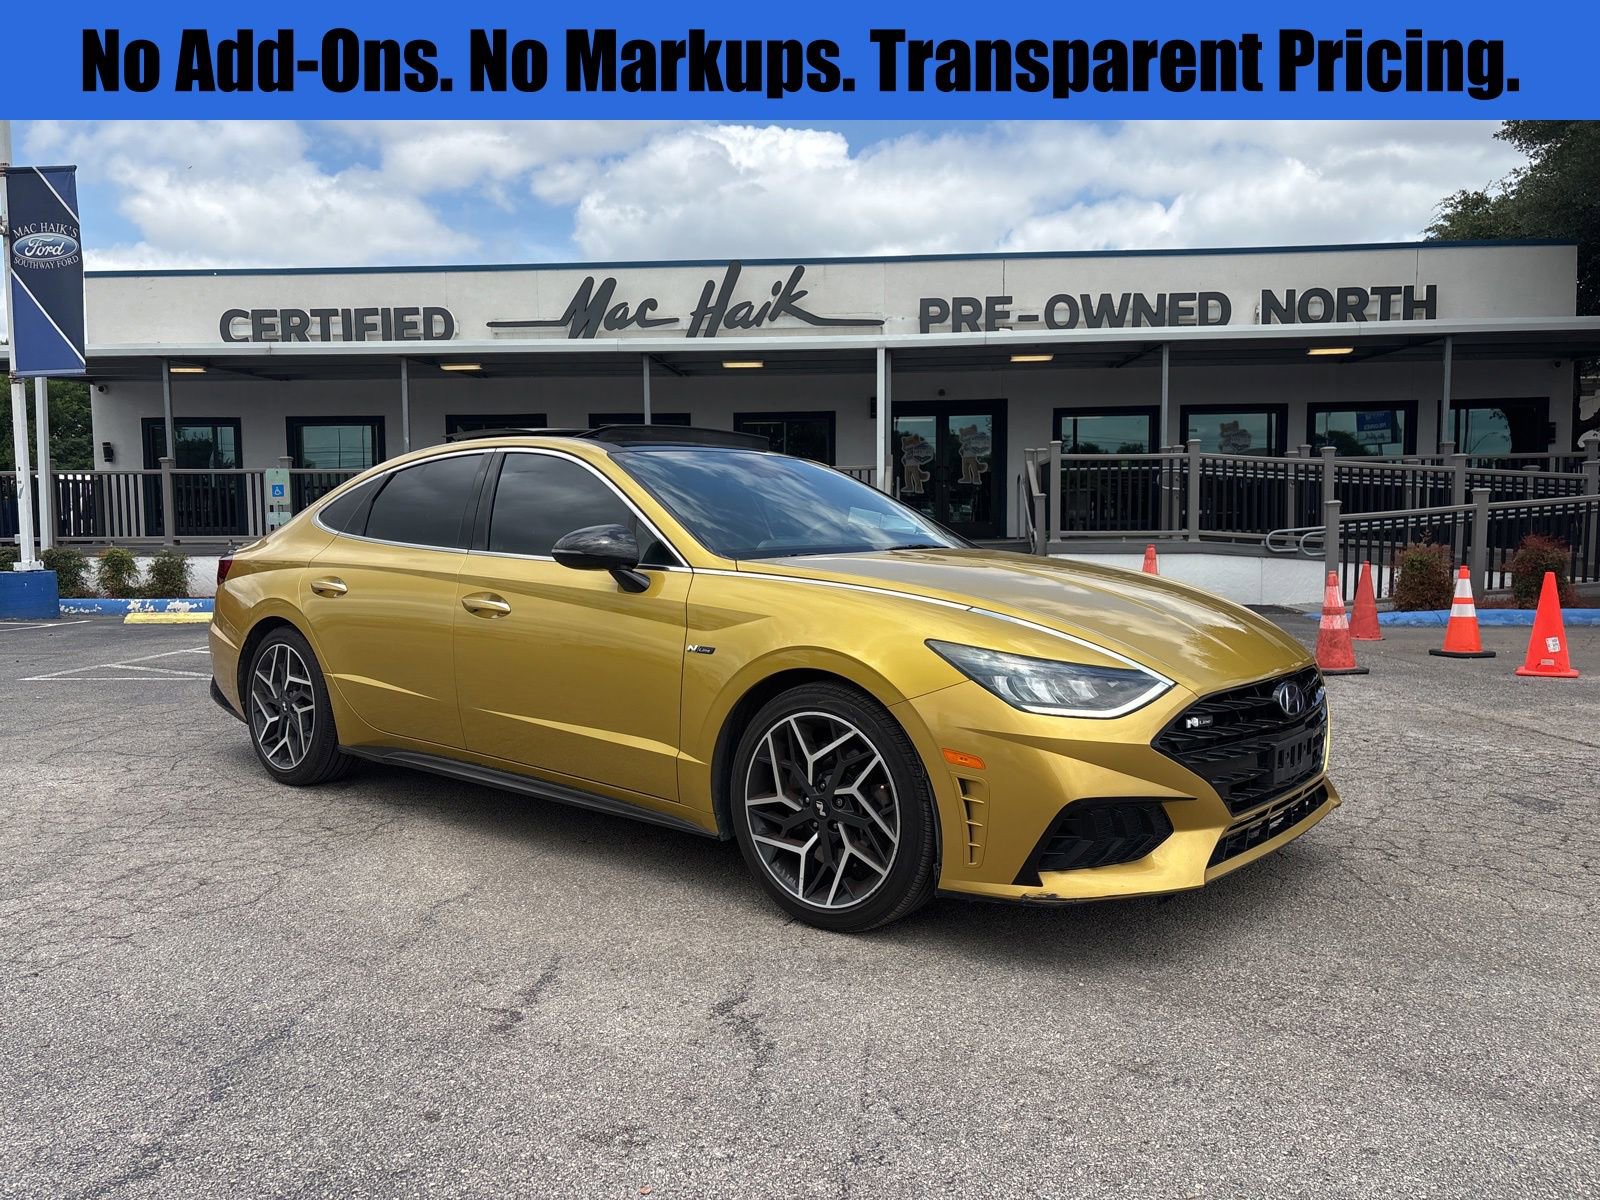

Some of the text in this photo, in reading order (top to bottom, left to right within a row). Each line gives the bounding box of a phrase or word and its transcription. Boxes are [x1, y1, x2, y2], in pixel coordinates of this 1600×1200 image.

[12, 222, 78, 239] MAC HAIK'S
[24, 237, 65, 257] Ford
[14, 255, 79, 270] SOUTHWAY FORD
[486, 260, 886, 340] Mac Haik
[919, 284, 1438, 334] PRE-OWNED NORTH
[219, 306, 455, 343] CERTIFIED
